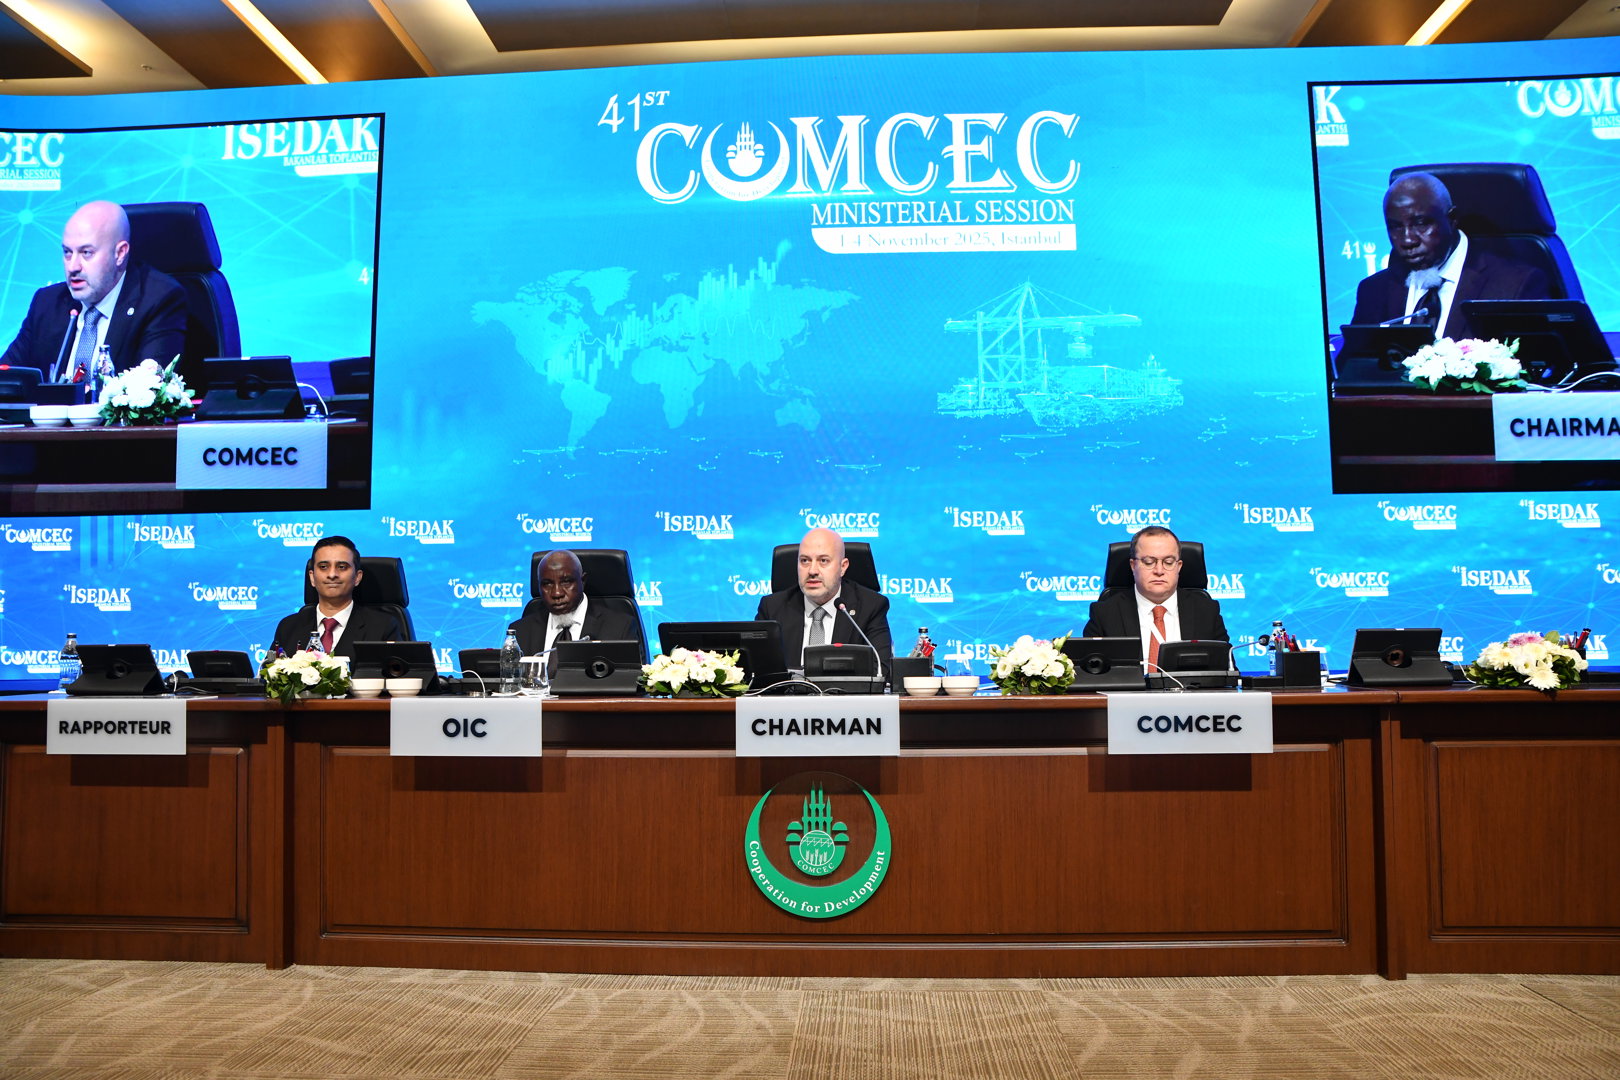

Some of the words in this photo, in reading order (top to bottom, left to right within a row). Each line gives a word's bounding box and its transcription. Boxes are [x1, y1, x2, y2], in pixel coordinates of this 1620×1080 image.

[636, 110, 1080, 204] COMCEC
[811, 200, 969, 226] MINISTERIAL
[975, 198, 1074, 223] SESSION
[868, 232, 949, 248] November
[954, 231, 995, 247] 2025,
[203, 447, 298, 466] COMCEC
[59, 720, 171, 734] RAPPORTEUR
[442, 718, 487, 738] OIC
[751, 717, 881, 736] CHAIRMAN
[1137, 715, 1242, 733] COMCEC
[797, 859, 834, 874] COMCEC
[749, 840, 798, 909] Cooperation
[800, 901, 820, 913] for
[824, 850, 886, 913] Development
